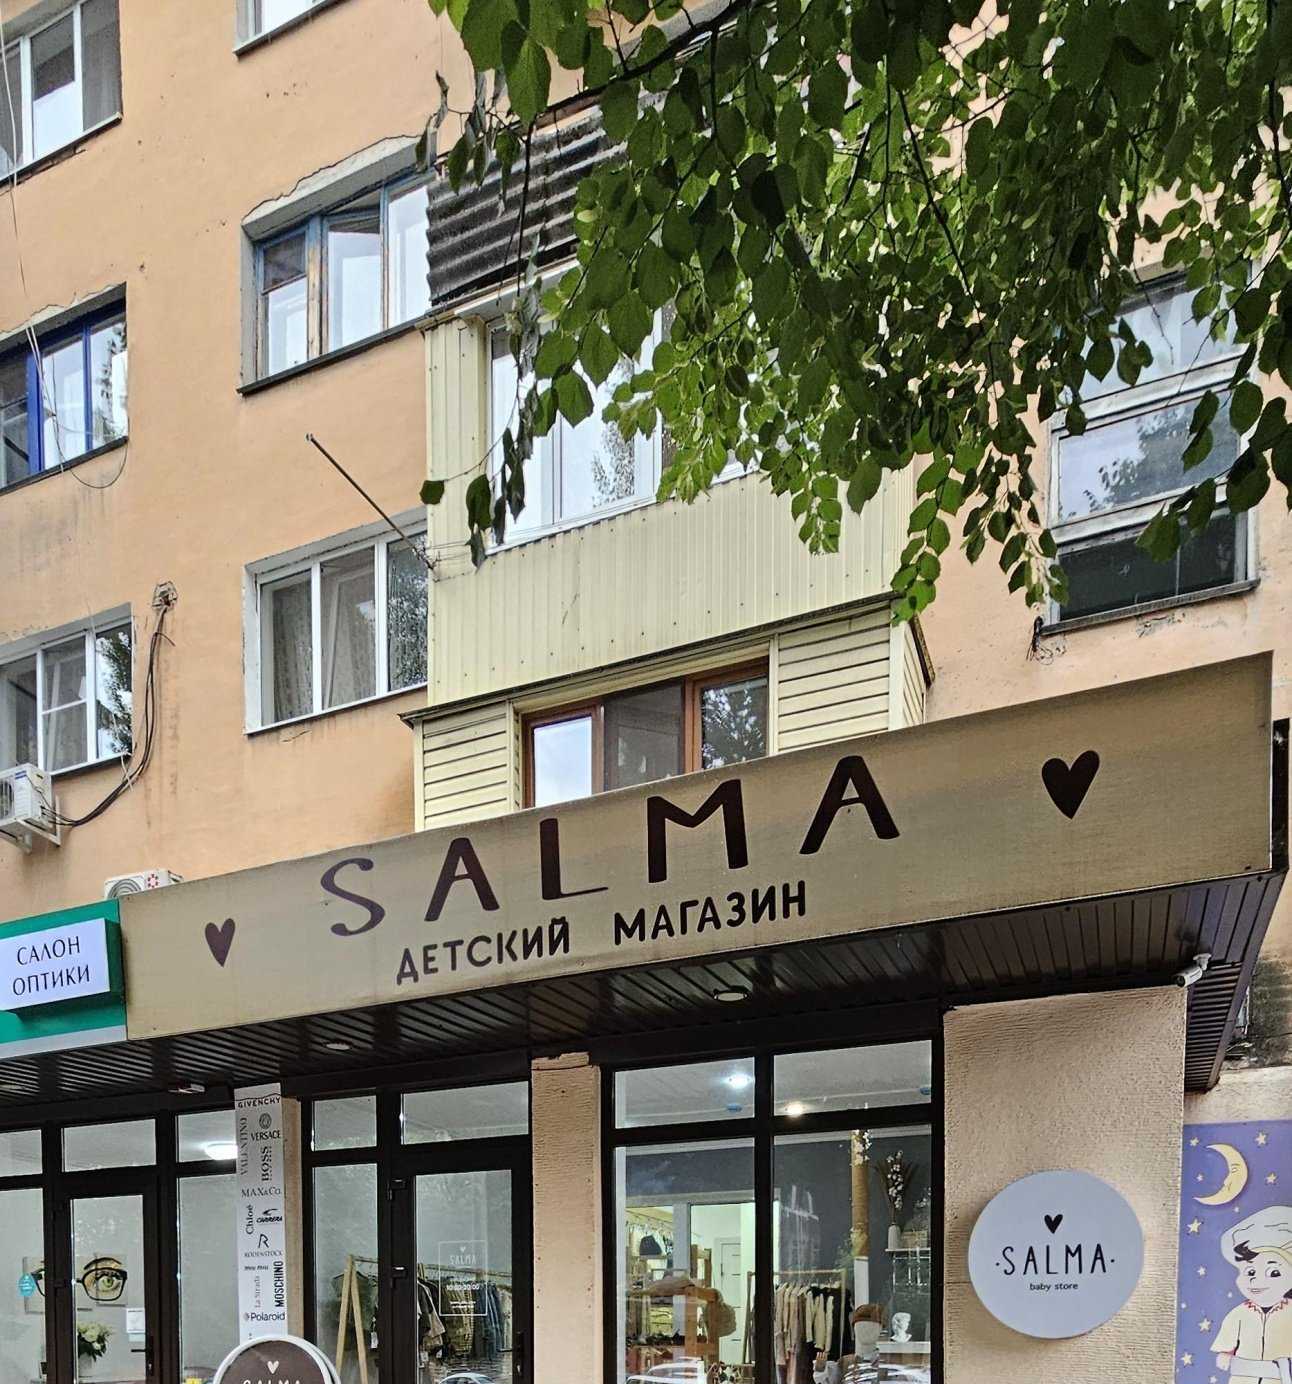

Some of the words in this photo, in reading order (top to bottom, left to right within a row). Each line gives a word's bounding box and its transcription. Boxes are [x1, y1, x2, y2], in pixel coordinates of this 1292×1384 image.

[320, 755, 900, 937] SALMA
[396, 916, 570, 986] ДЕТСКИЙ
[614, 880, 807, 946] МАГАЗИН
[17, 936, 80, 965] САЛОН
[12, 964, 90, 996] ОПТИКИ
[237, 1096, 281, 1109] GIVENCHY
[250, 1130, 281, 1141] VERSACE
[261, 1146, 271, 1181] BOSS
[273, 1260, 285, 1308] MOSCHINO
[1029, 1283, 1052, 1292] baby
[1054, 1283, 1078, 1291] store
[250, 1312, 285, 1321] Polaroid
